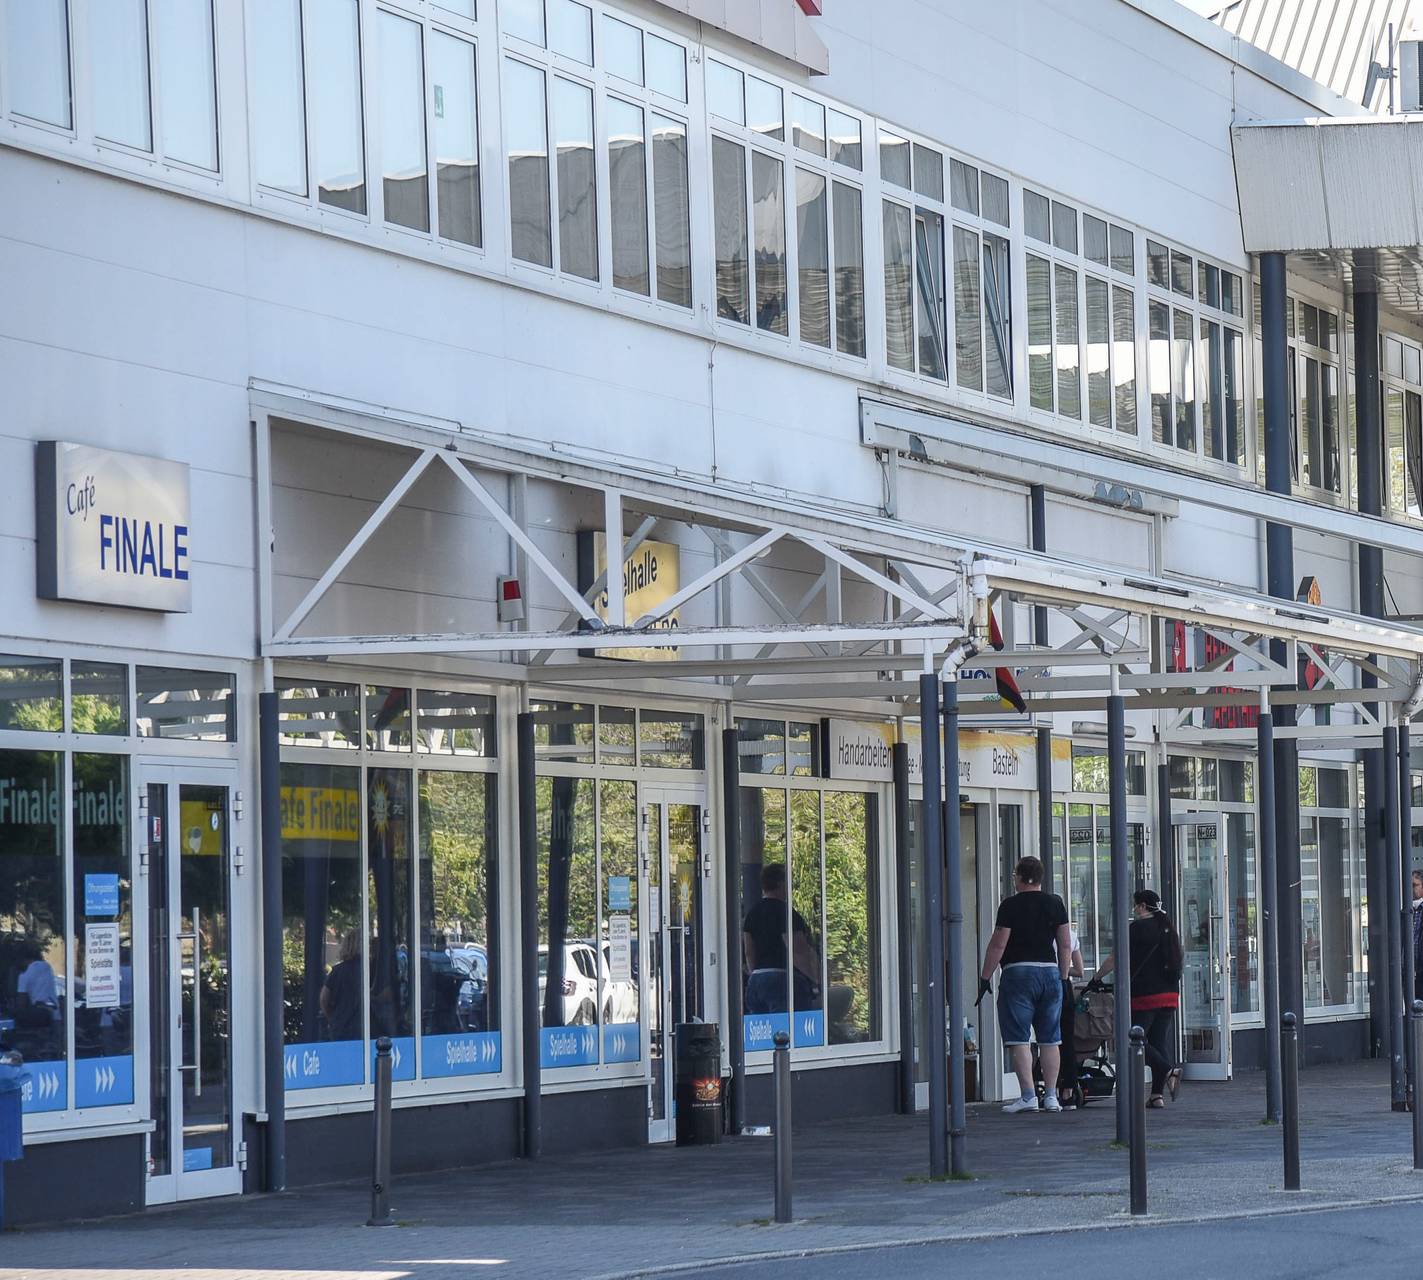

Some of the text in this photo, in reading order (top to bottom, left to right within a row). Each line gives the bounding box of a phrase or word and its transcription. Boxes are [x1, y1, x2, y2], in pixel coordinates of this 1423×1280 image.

[66, 475, 96, 521] Café
[100, 514, 189, 581] FINALE
[838, 735, 892, 769] Handarbeiten
[992, 747, 1019, 777] Basteln
[0, 777, 61, 825] Finale
[311, 790, 358, 832] Finale
[446, 1039, 477, 1069] Spielhalle
[550, 1032, 577, 1061] Spielhalle
